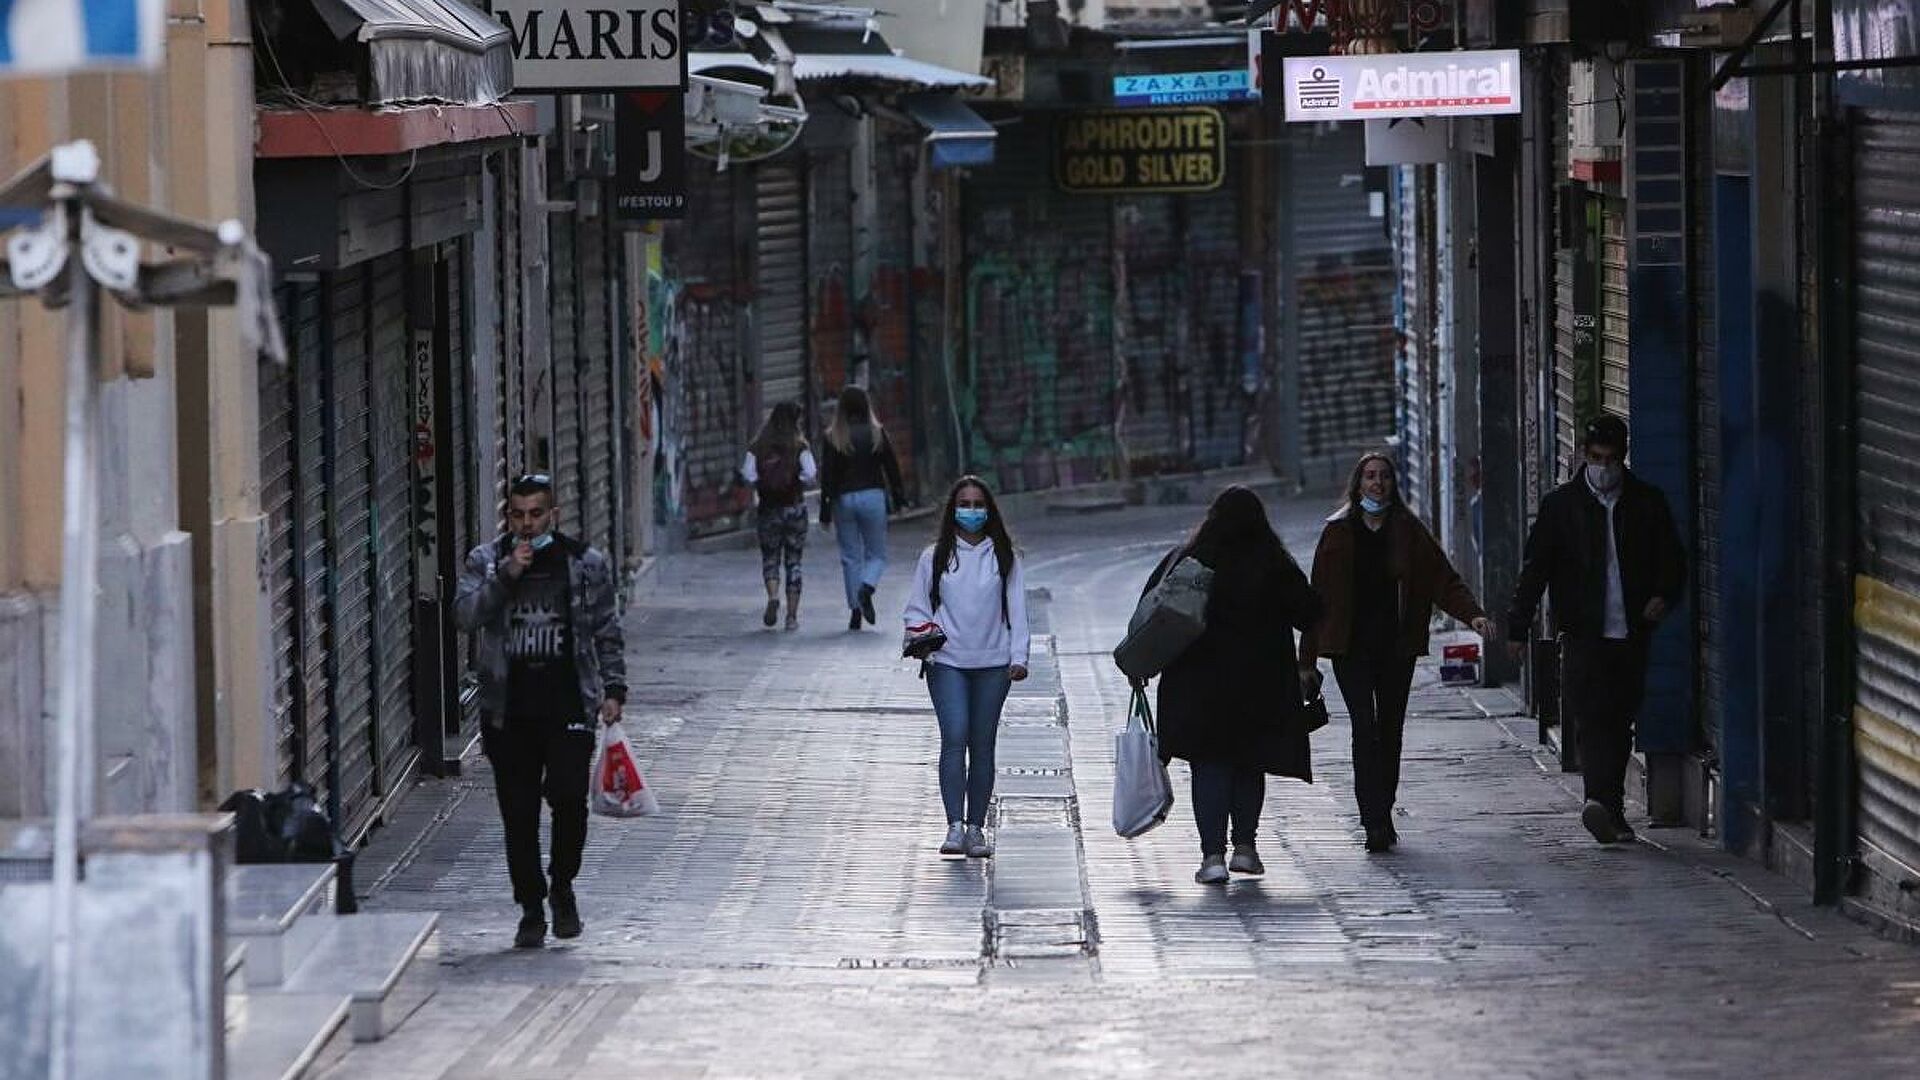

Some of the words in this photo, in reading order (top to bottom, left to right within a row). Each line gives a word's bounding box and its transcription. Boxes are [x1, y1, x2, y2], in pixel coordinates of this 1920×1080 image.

[495, 9, 678, 60] MARIS
[1356, 62, 1511, 99] Admiral
[1301, 97, 1339, 108] Admiral
[1064, 115, 1215, 150] APHRODITE
[640, 130, 661, 182] J
[1067, 154, 1126, 185] GOLD
[1137, 151, 1214, 183] SILVER
[618, 196, 672, 208] IFESTOU
[676, 195, 684, 208] 9
[510, 622, 566, 656] WHITE
